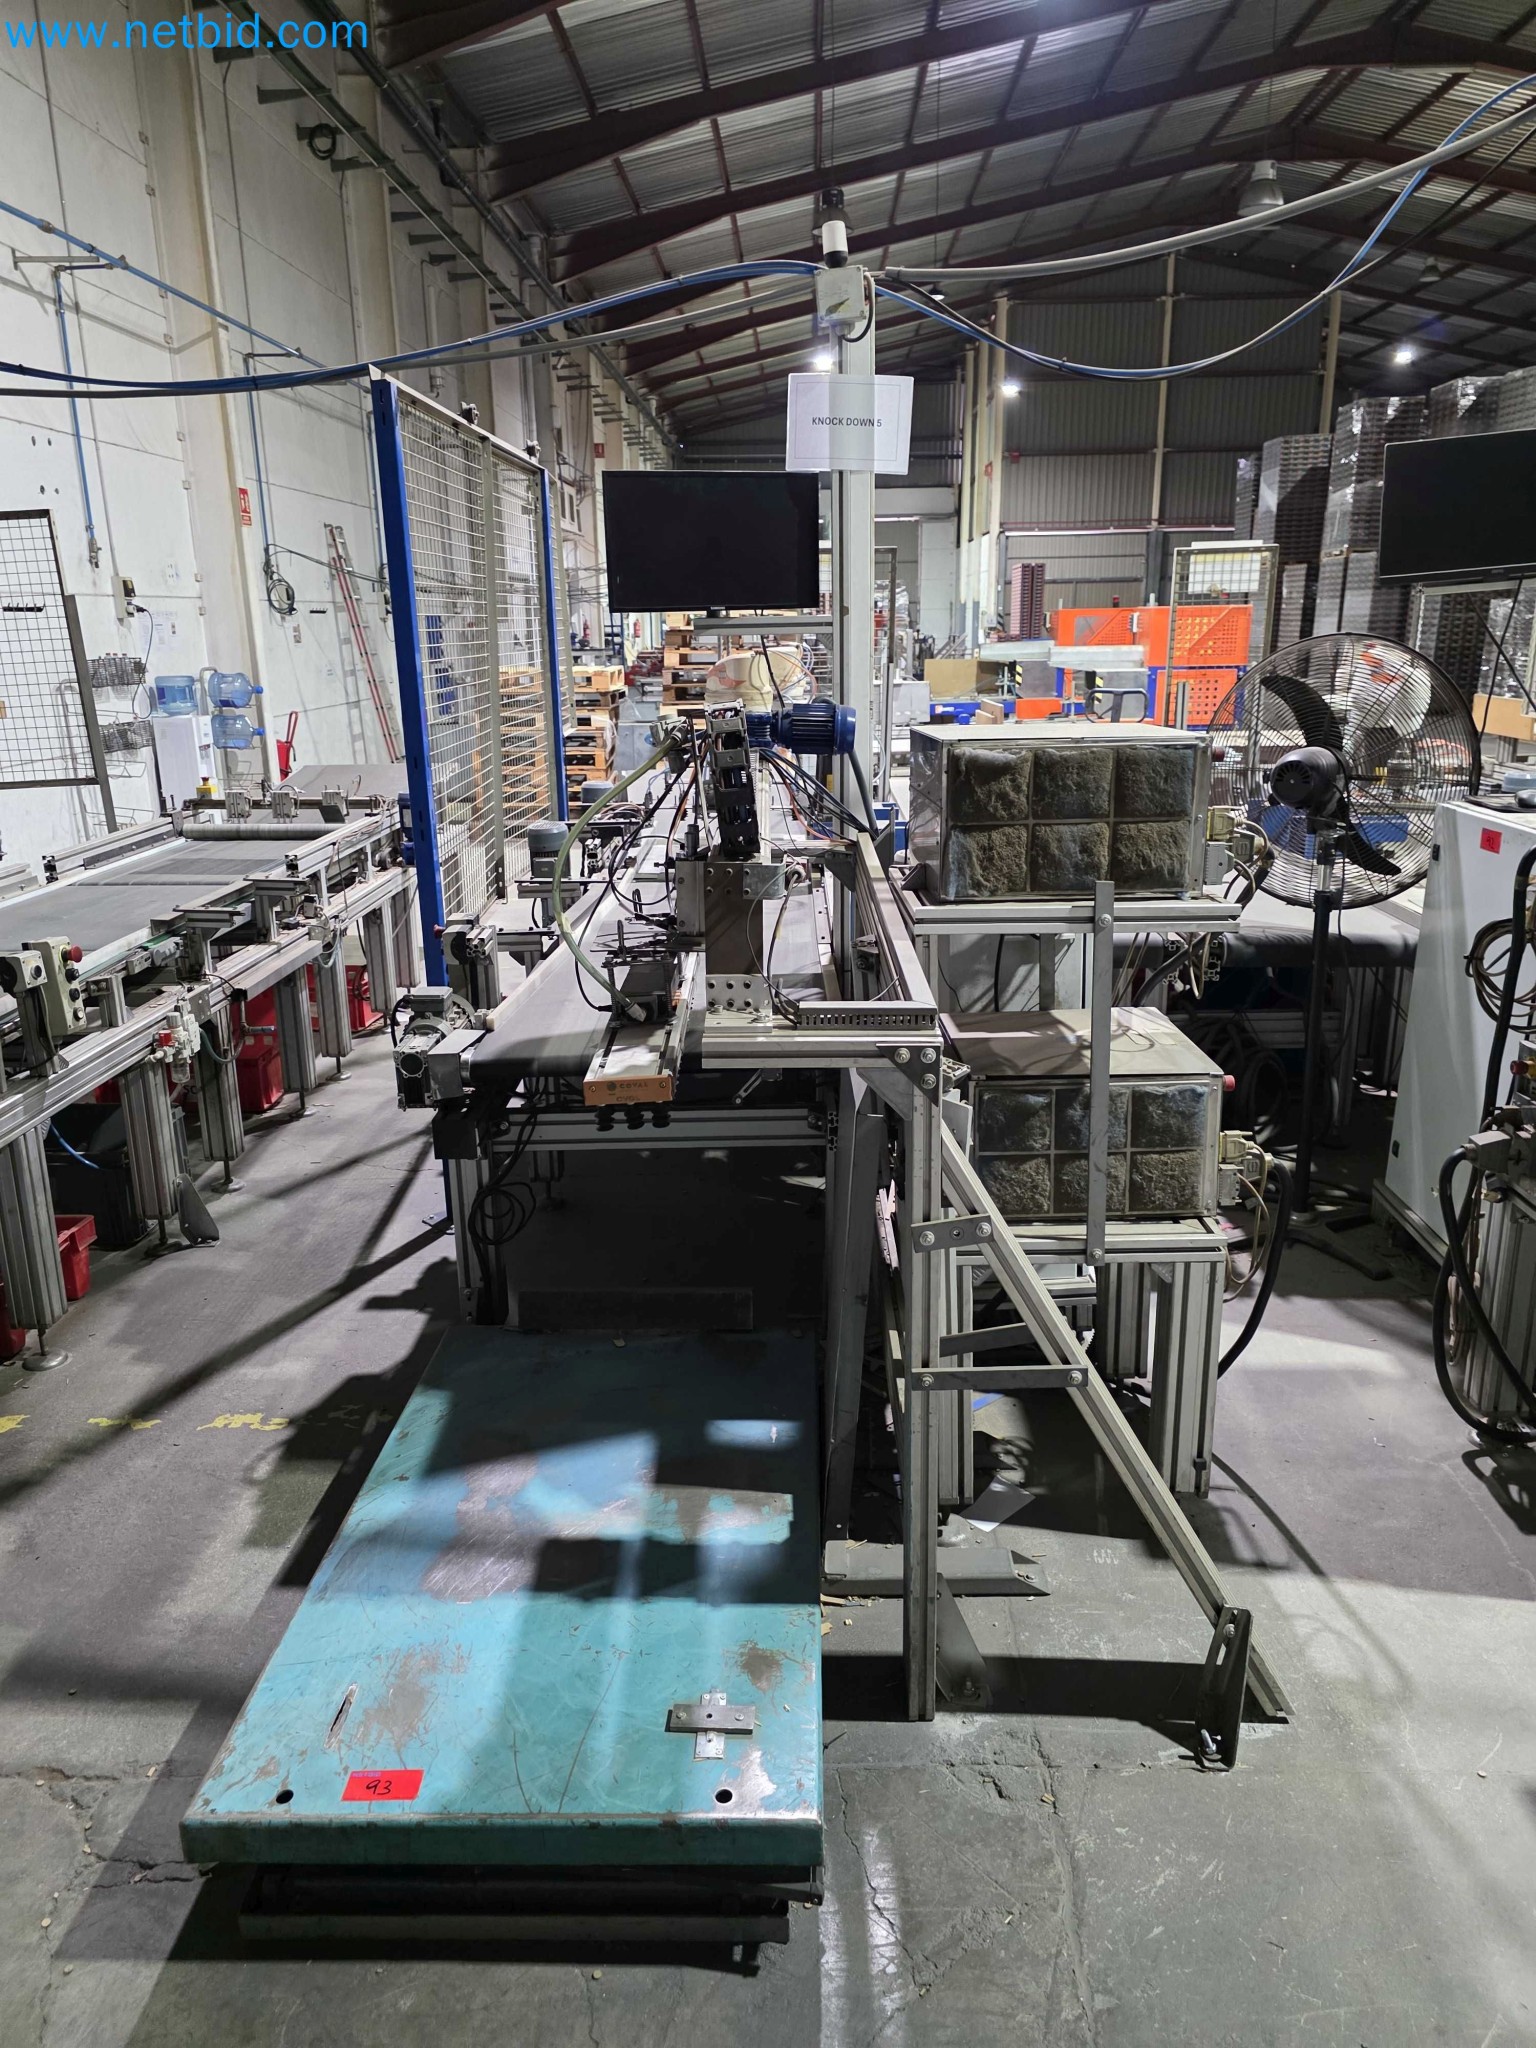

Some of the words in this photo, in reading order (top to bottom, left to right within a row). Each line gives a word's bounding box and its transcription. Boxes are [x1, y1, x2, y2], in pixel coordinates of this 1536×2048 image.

[811, 417, 844, 426] KNOCK
[846, 417, 874, 427] DOWN
[876, 418, 882, 427] 5
[619, 1081, 649, 1089] COVAL
[365, 1779, 392, 1796] 93
